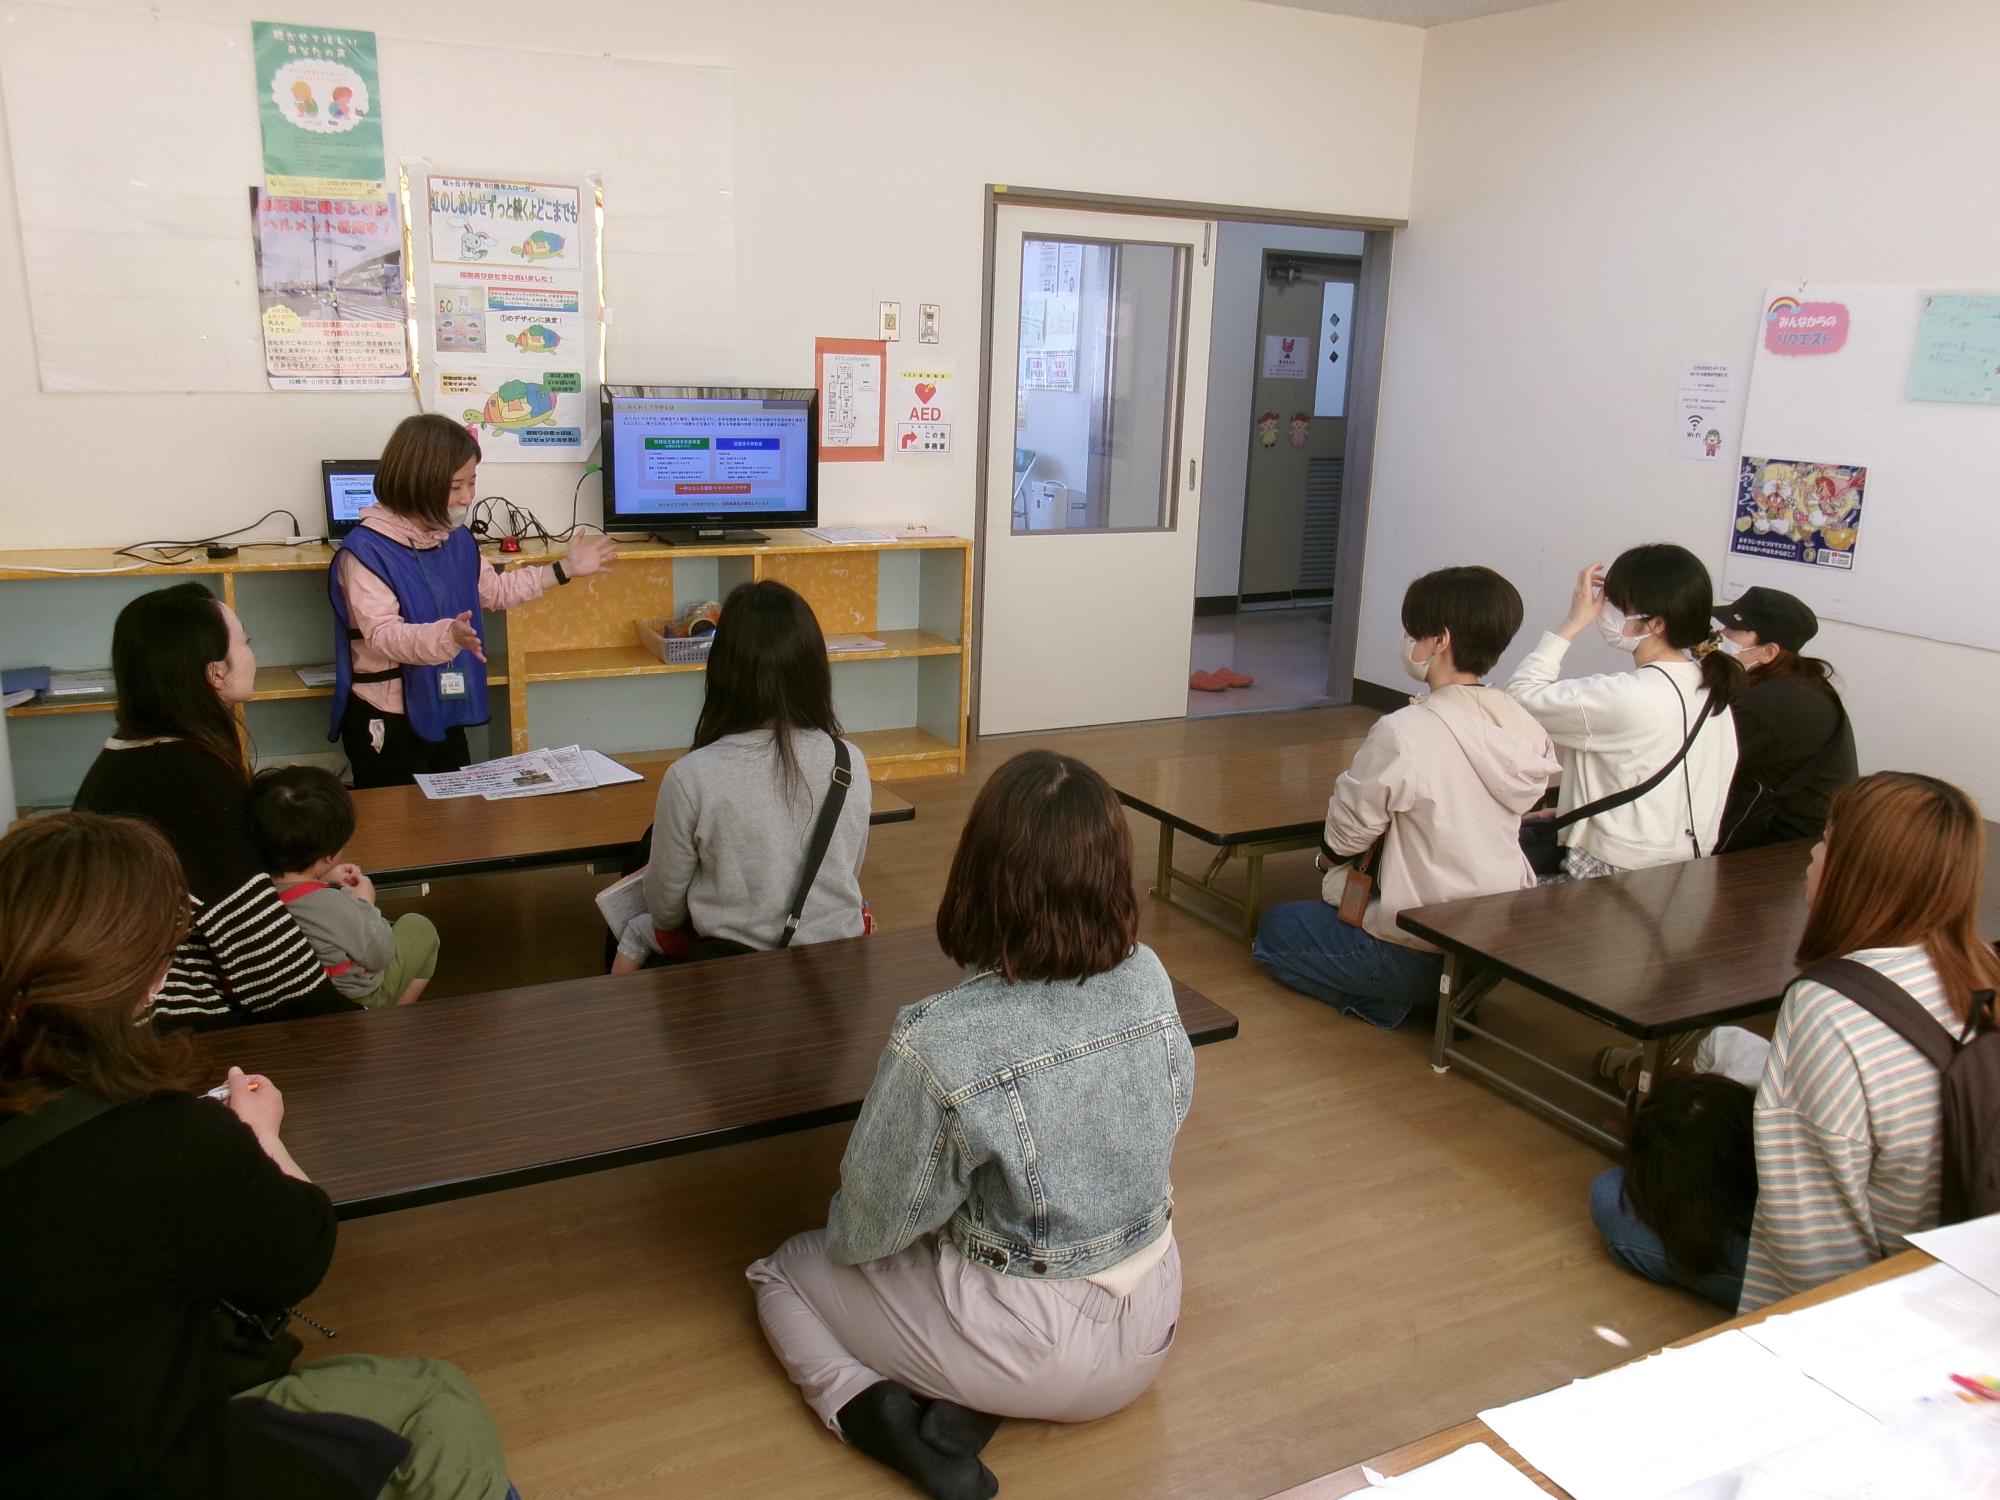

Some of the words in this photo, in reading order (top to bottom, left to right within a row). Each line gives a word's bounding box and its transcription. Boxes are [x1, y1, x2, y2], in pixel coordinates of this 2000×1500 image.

[1778, 315, 1837, 328] みんなからの
[1776, 332, 1832, 347] リクエスト
[909, 407, 942, 421] AED
[925, 432, 946, 440] この先
[924, 442, 946, 450] 事務室
